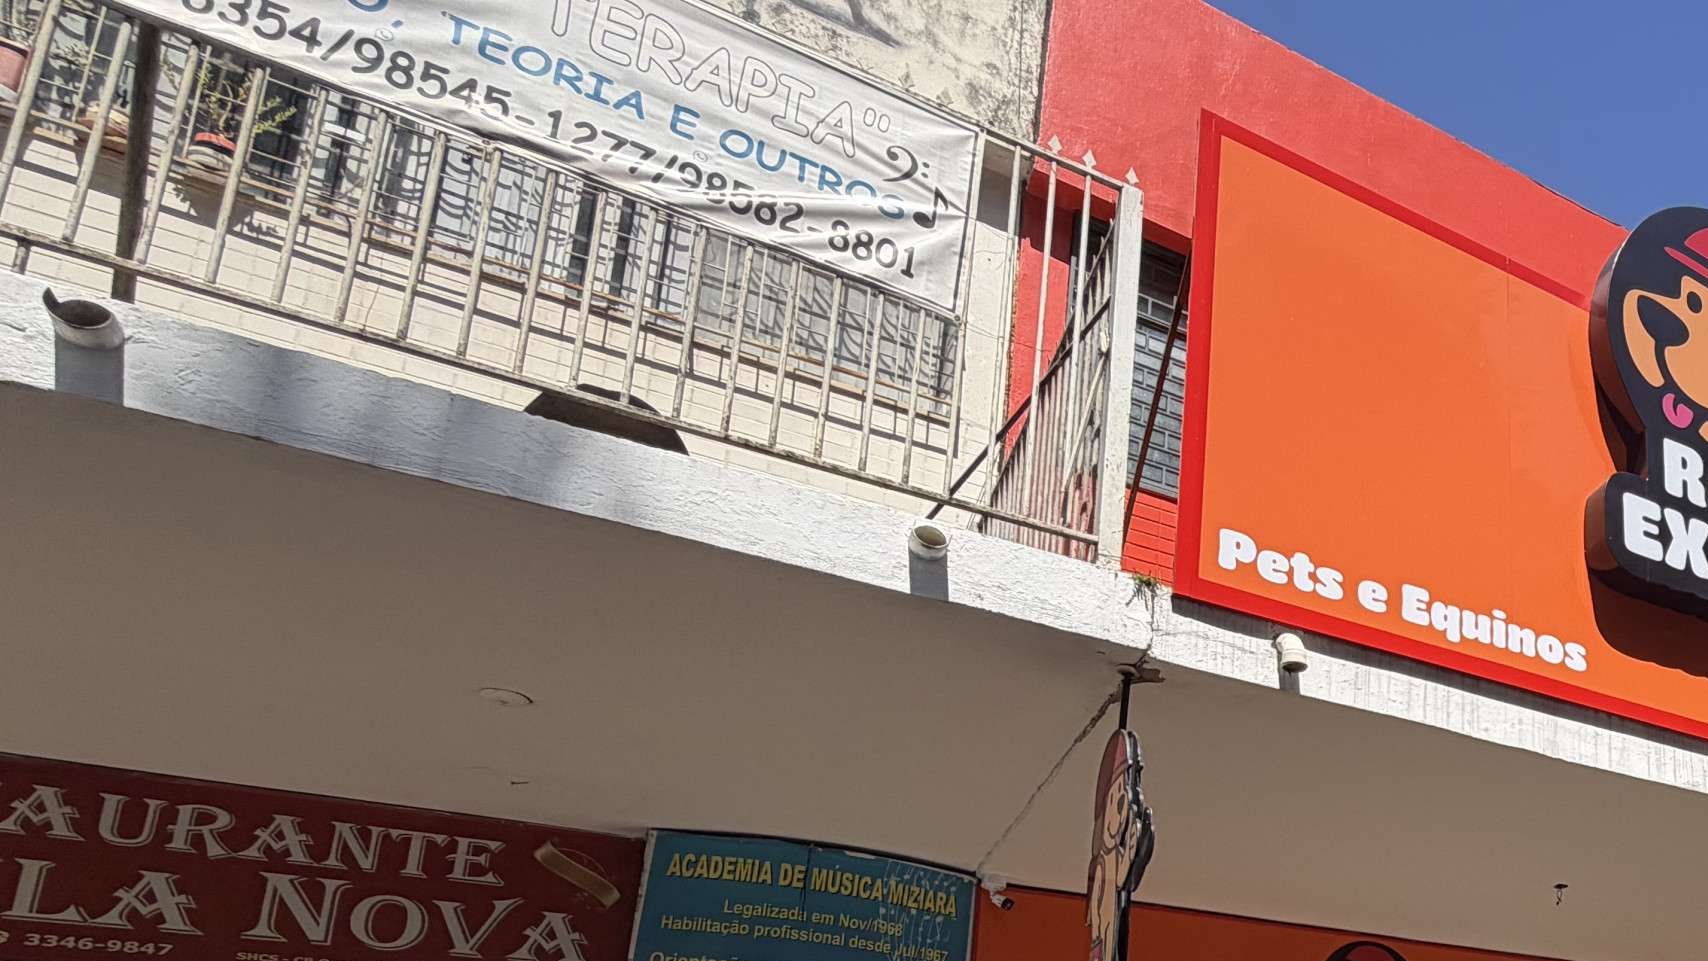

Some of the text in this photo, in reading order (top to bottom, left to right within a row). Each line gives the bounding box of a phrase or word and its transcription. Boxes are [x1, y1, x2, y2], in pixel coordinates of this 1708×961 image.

[448, 11, 905, 220] TEORIA E OUTROS
[1217, 527, 1589, 673] Pets e Equinos
[666, 852, 958, 919] ACADEMIA DE MÚSICA MIZIARA
[660, 914, 750, 937] Habilitação
[753, 923, 845, 947] profissional
[848, 935, 892, 954] desde
[723, 899, 835, 927] Legalizada em
[23, 932, 174, 957] 3346-9847
